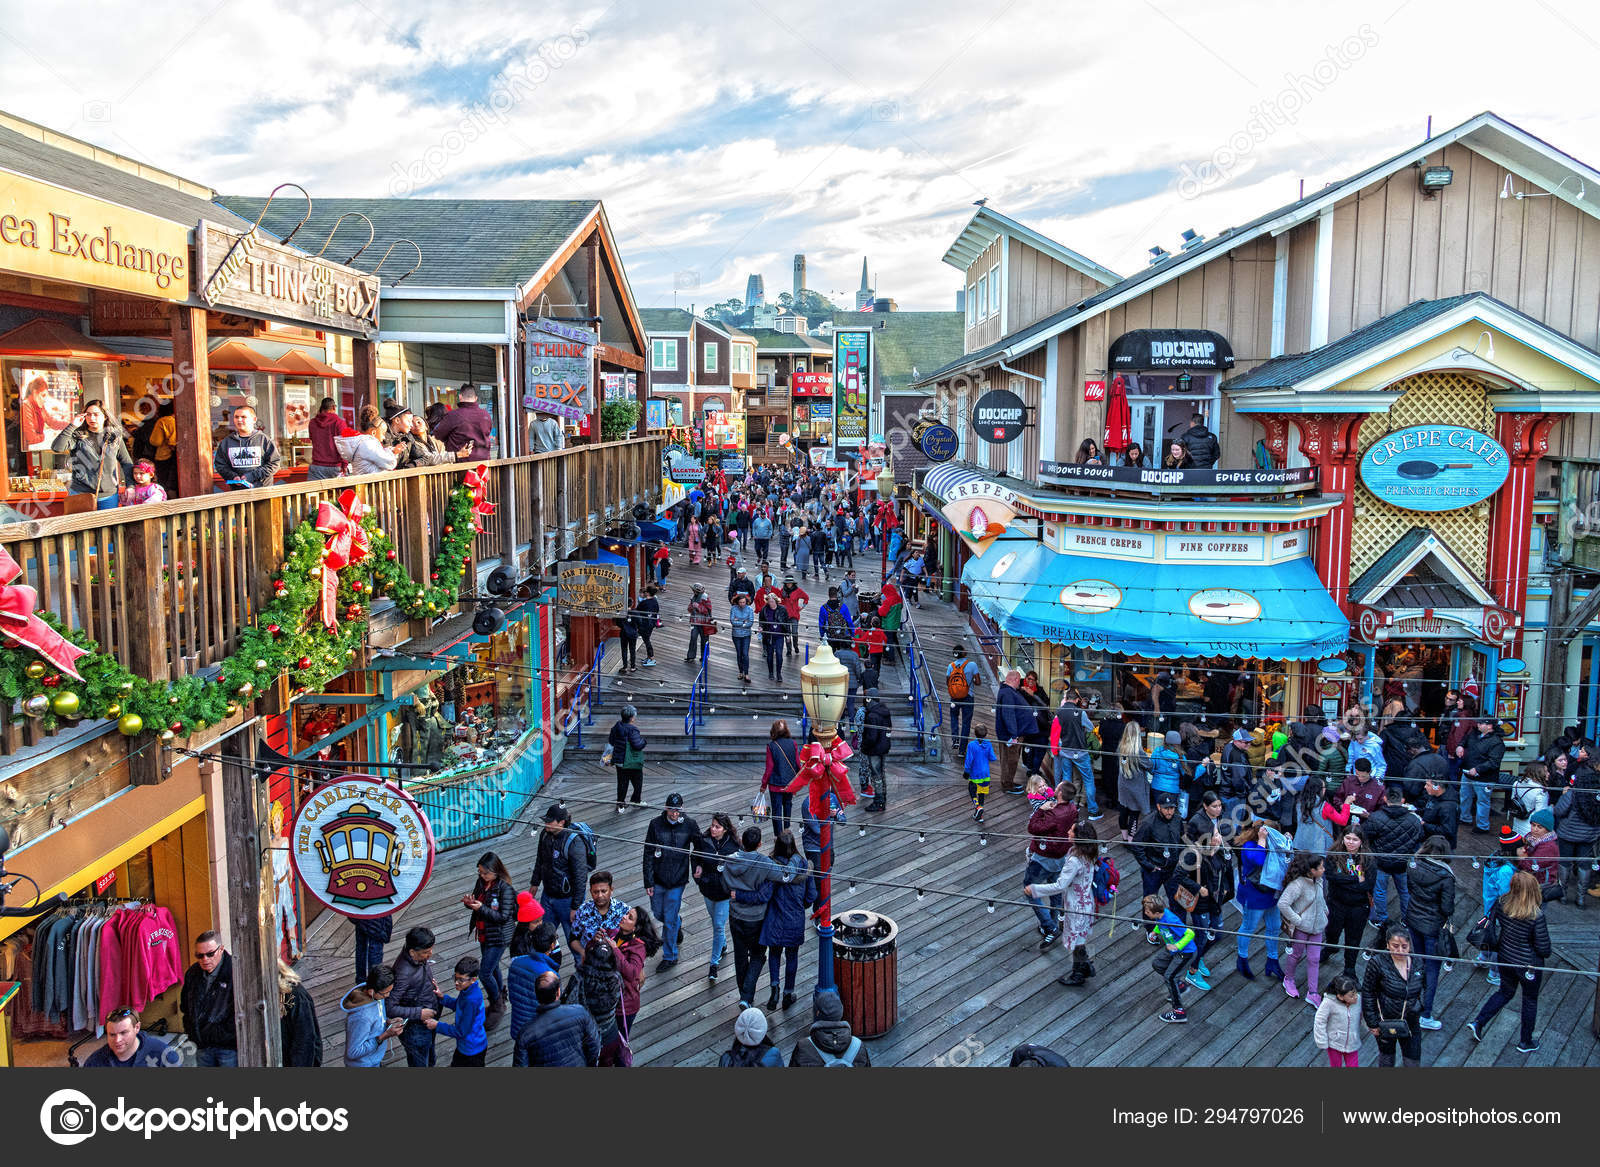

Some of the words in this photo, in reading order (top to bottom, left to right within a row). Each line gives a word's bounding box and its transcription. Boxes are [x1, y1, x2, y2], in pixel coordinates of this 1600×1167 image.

[49, 212, 184, 289] Exchange
[312, 264, 335, 284] OUT
[245, 256, 310, 304] THINK
[334, 281, 378, 319] BOX
[316, 285, 331, 300] OF
[314, 300, 334, 318] THE
[543, 321, 589, 342] GAMES
[532, 342, 585, 358] THINK
[1152, 341, 1215, 357] DOUGHP
[536, 381, 586, 407] BOX
[1086, 384, 1103, 399] illy
[524, 397, 581, 420] PUZZLES
[979, 408, 1022, 419] DOUGHP
[926, 434, 954, 446] Crystal
[930, 445, 949, 458] Shop
[1448, 431, 1504, 466] CAFE
[1084, 468, 1114, 477] DOUGH
[1141, 471, 1184, 484] DOUGHP
[1215, 473, 1252, 482] EDIBLE
[948, 483, 1015, 502] CREPES
[1385, 485, 1435, 496] FRENCH
[1436, 487, 1479, 497] CREPES
[1075, 535, 1107, 546] FRENCH
[1110, 538, 1142, 549] CREPES
[1180, 543, 1203, 551] FINE
[1208, 543, 1248, 552] COFFEES
[1042, 624, 1111, 645] BREAKFAST
[1210, 641, 1259, 652] LUNCH
[304, 784, 360, 822] CABLE
[365, 786, 402, 815] CAR
[299, 825, 311, 854] THE
[400, 815, 423, 859] STORE
[353, 870, 378, 879] FRANCISCO
